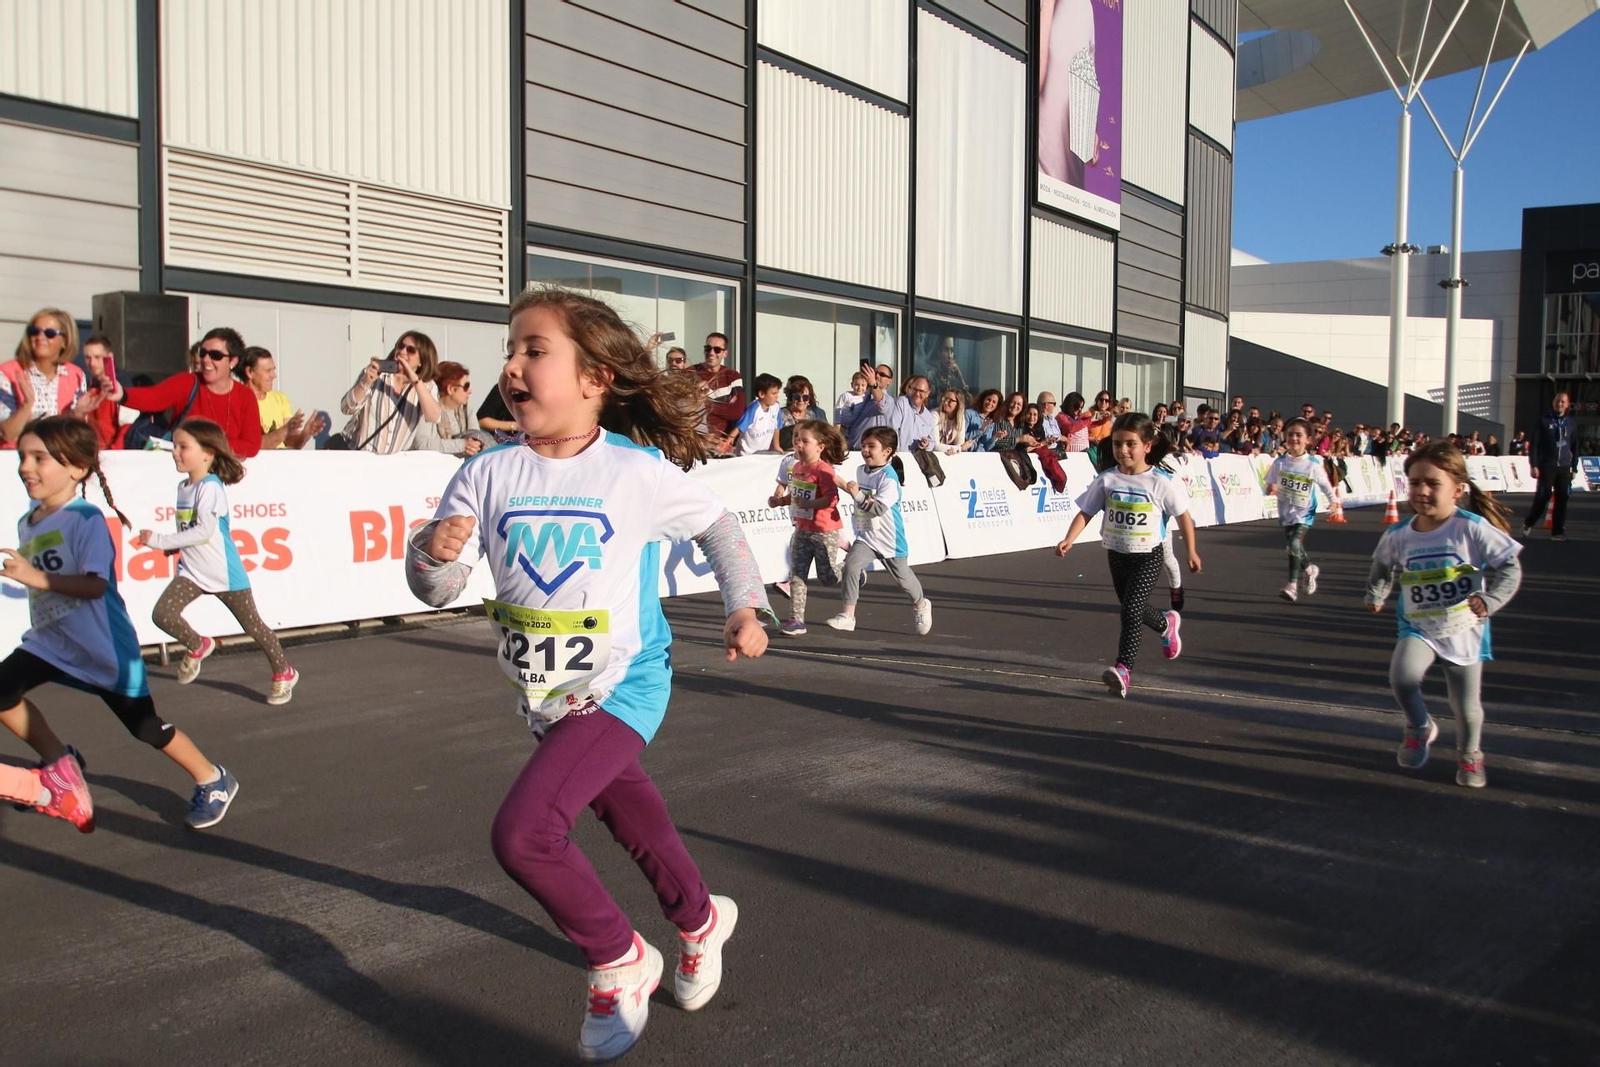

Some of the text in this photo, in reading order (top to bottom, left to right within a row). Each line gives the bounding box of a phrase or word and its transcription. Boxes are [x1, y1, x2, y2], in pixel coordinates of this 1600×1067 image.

[1280, 477, 1309, 492] 8318
[980, 486, 1006, 500] inelsa
[508, 495, 604, 509] SUPER RUNNER
[1051, 501, 1072, 512] ZENER
[233, 503, 287, 519] SHOES
[985, 504, 1011, 518] ZENER
[1108, 509, 1148, 526] 8062
[1410, 576, 1472, 604] 8399
[531, 621, 552, 629] 2020
[518, 672, 546, 684] ALBA
